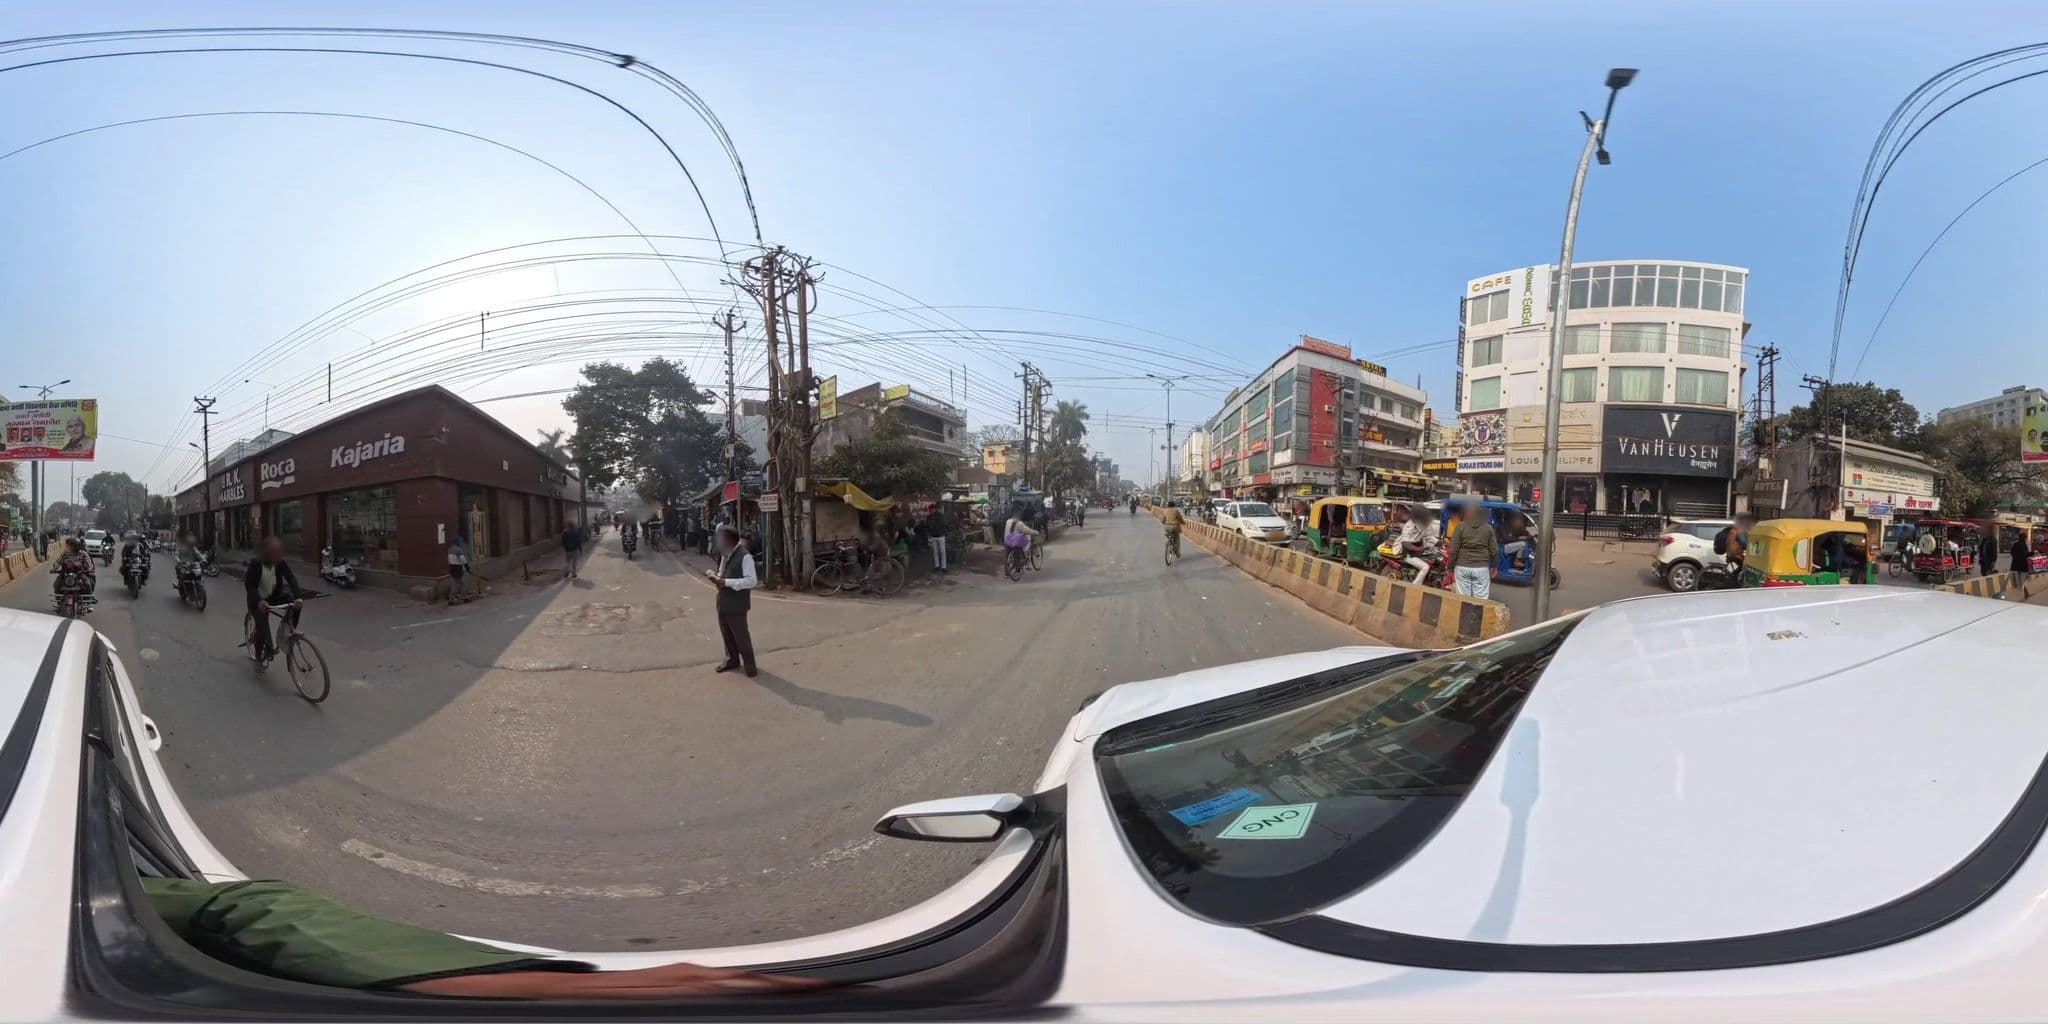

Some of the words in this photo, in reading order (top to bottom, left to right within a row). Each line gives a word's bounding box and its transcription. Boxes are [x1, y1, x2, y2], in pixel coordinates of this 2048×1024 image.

[1472, 276, 1511, 292] CAFE
[330, 432, 406, 468] Kajaria
[261, 457, 295, 481] Roca
[1242, 809, 1300, 833] CNG
